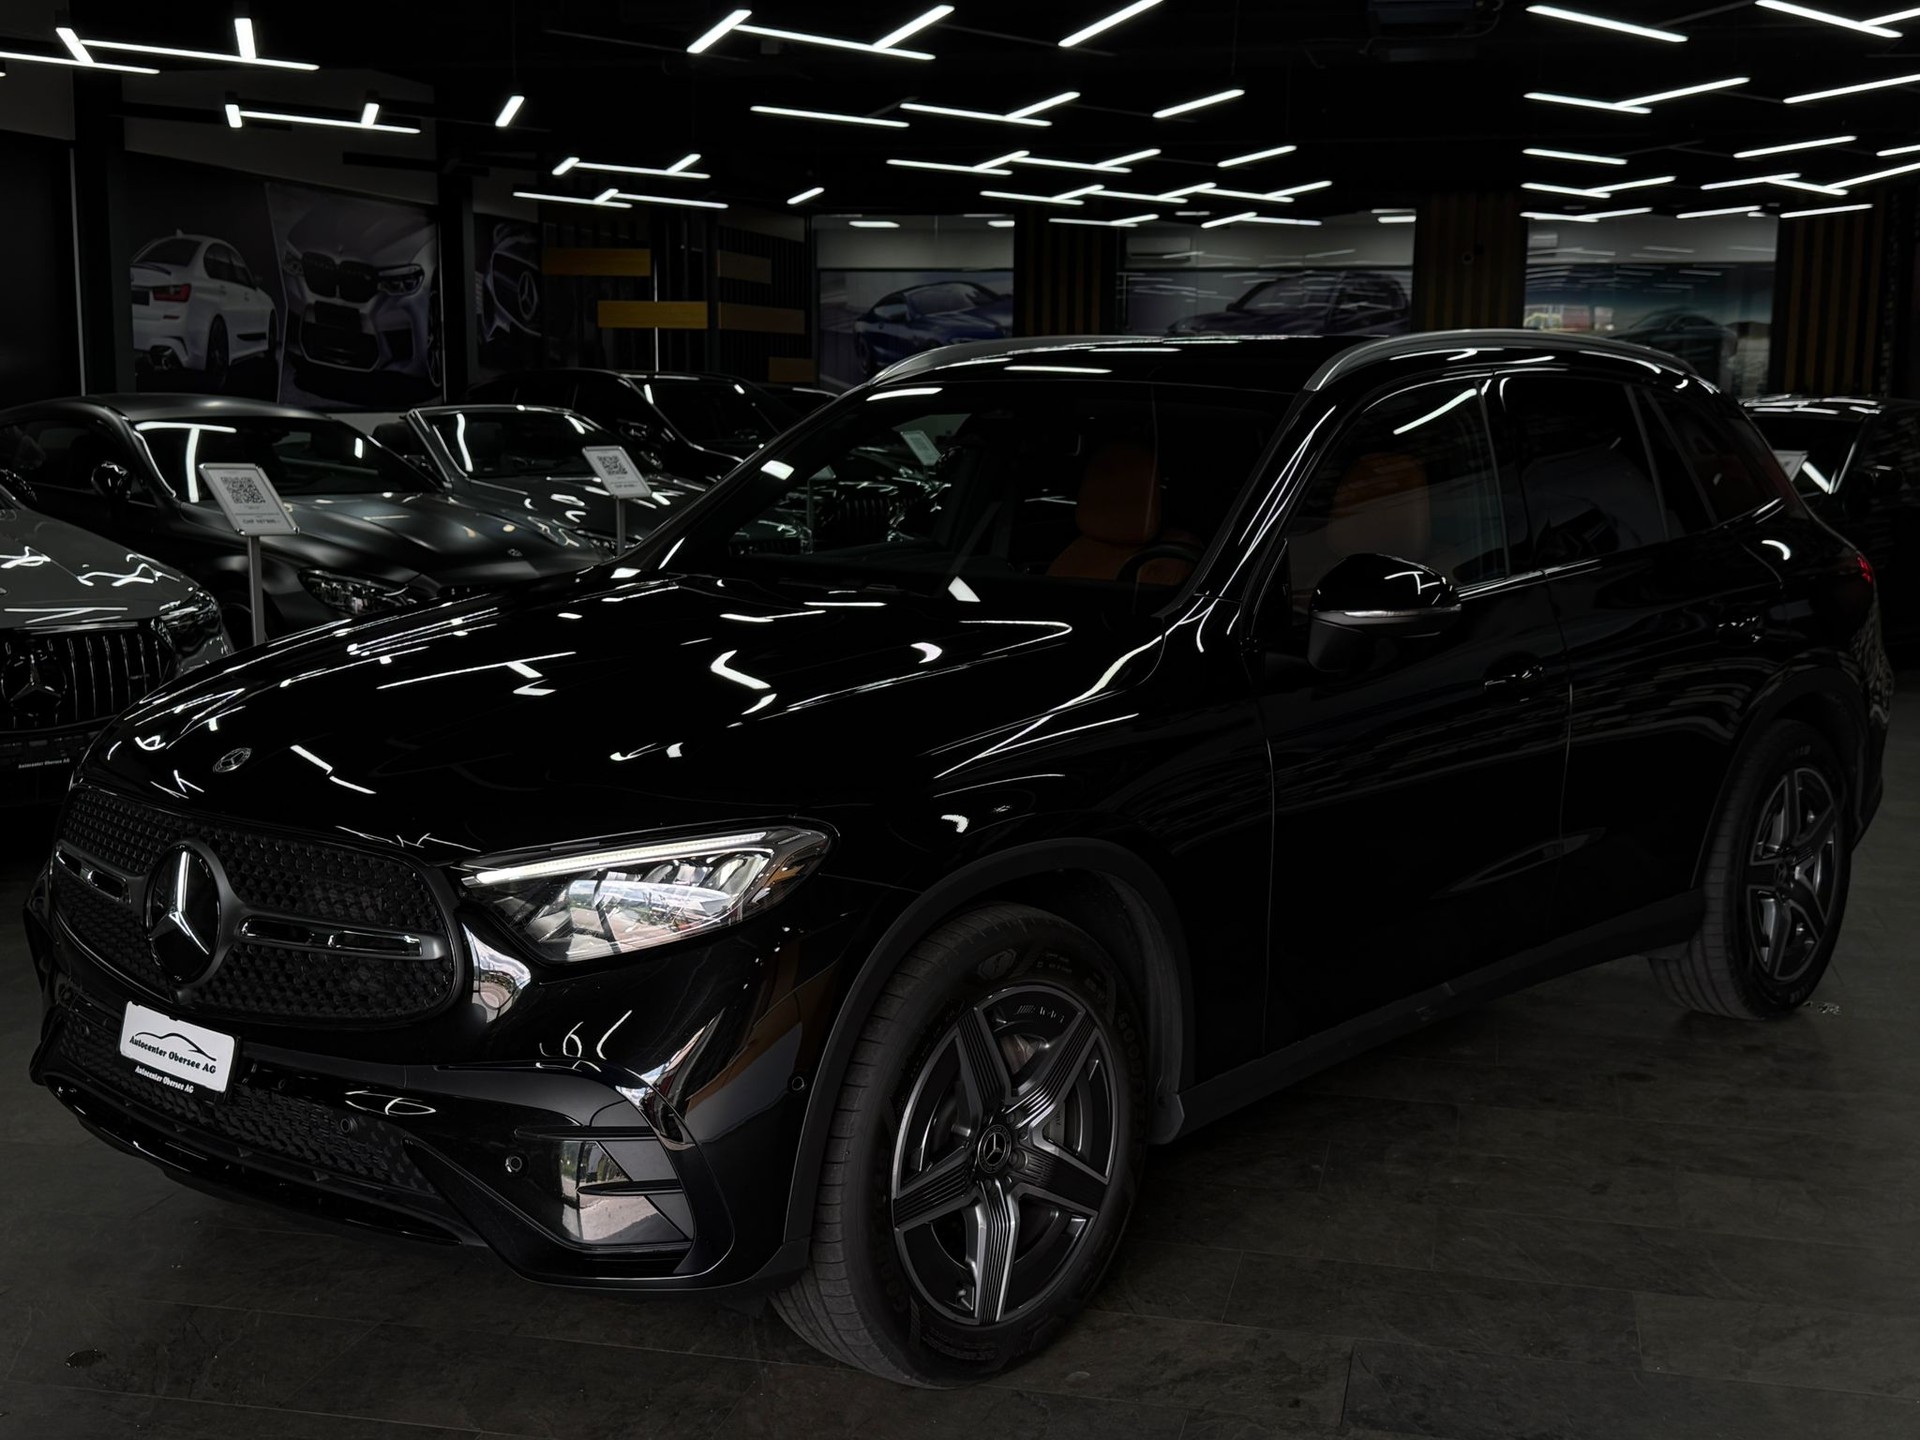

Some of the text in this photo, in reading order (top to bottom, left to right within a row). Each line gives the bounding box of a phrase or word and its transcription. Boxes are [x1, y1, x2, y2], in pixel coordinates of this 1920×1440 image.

[129, 1035, 216, 1074] Autocenter Obersee AG
[134, 1065, 194, 1094] Autocenter Obersee AG
